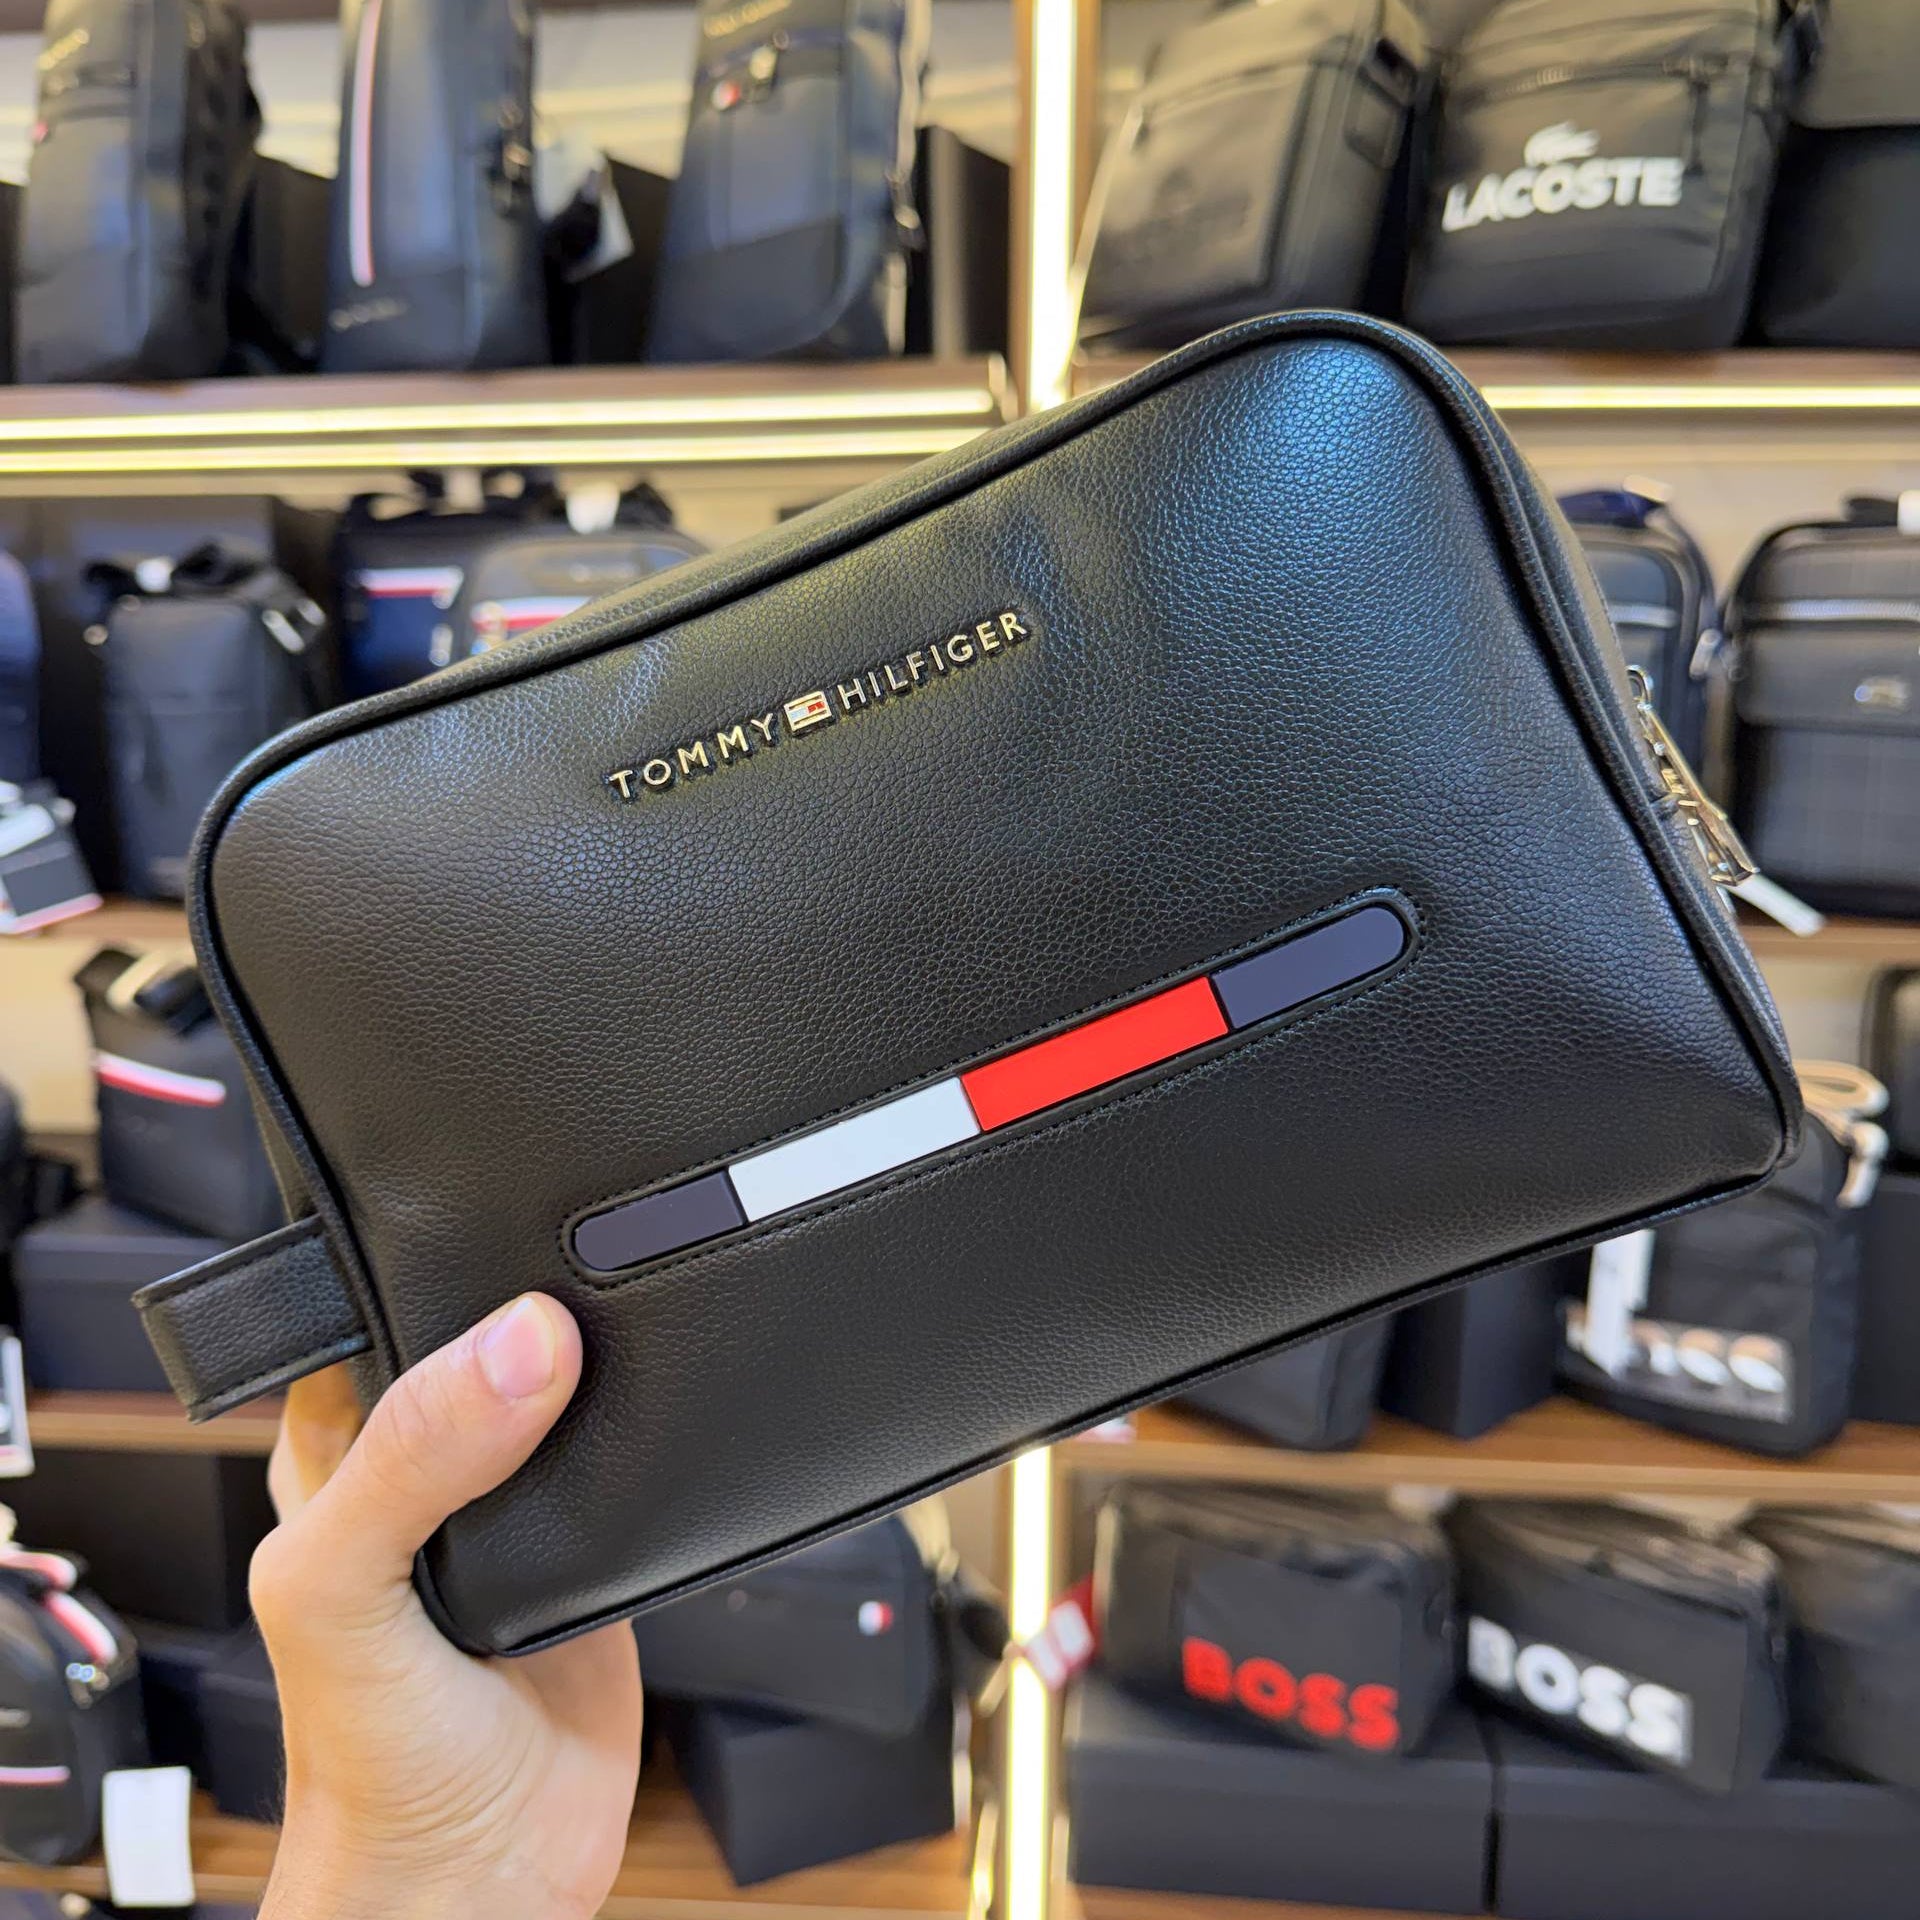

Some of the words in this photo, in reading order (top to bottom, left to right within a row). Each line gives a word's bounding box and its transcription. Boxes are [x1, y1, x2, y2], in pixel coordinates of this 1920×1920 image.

[1443, 157, 1684, 231] LACOSTE
[609, 713, 774, 798] TOMMY
[836, 611, 1027, 710] HILFIGER
[1183, 1637, 1400, 1751] BOSS
[1468, 1615, 1693, 1766] BOSS
